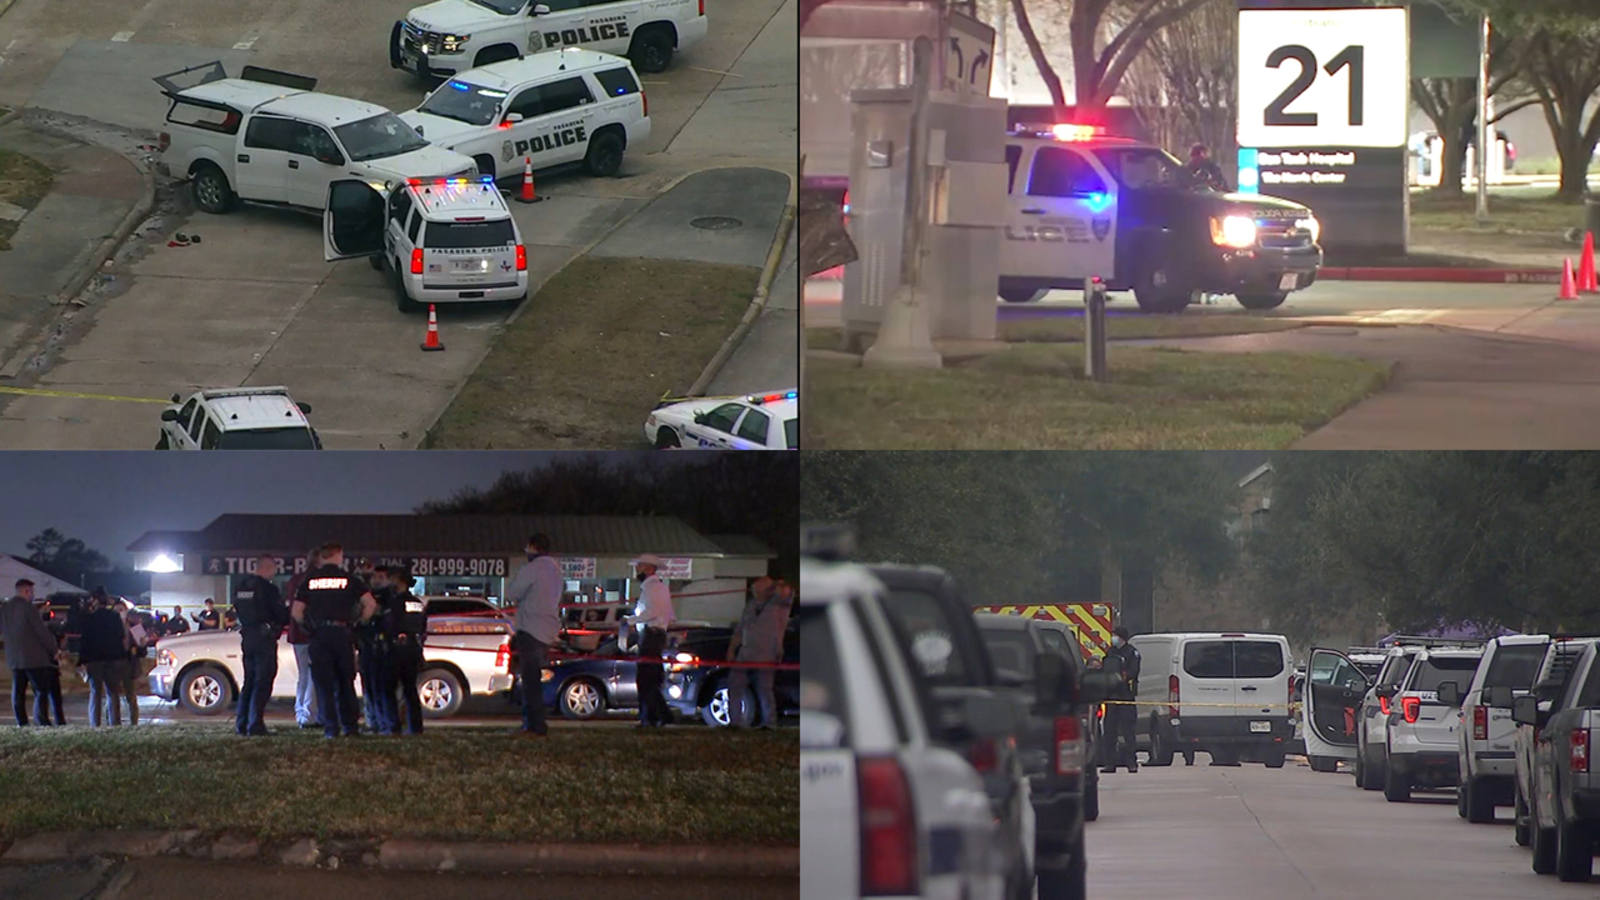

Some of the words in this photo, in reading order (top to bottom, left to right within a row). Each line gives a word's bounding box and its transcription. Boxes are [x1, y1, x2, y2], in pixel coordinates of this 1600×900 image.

[541, 22, 630, 49] POLICE
[1263, 44, 1365, 127] 21
[515, 126, 588, 157] POLICE
[1311, 171, 1346, 183] Center
[1003, 225, 1090, 243] LICE
[481, 246, 510, 254] POLICE
[411, 558, 505, 576] 281-999-9078
[308, 578, 348, 590] SHERIFF
